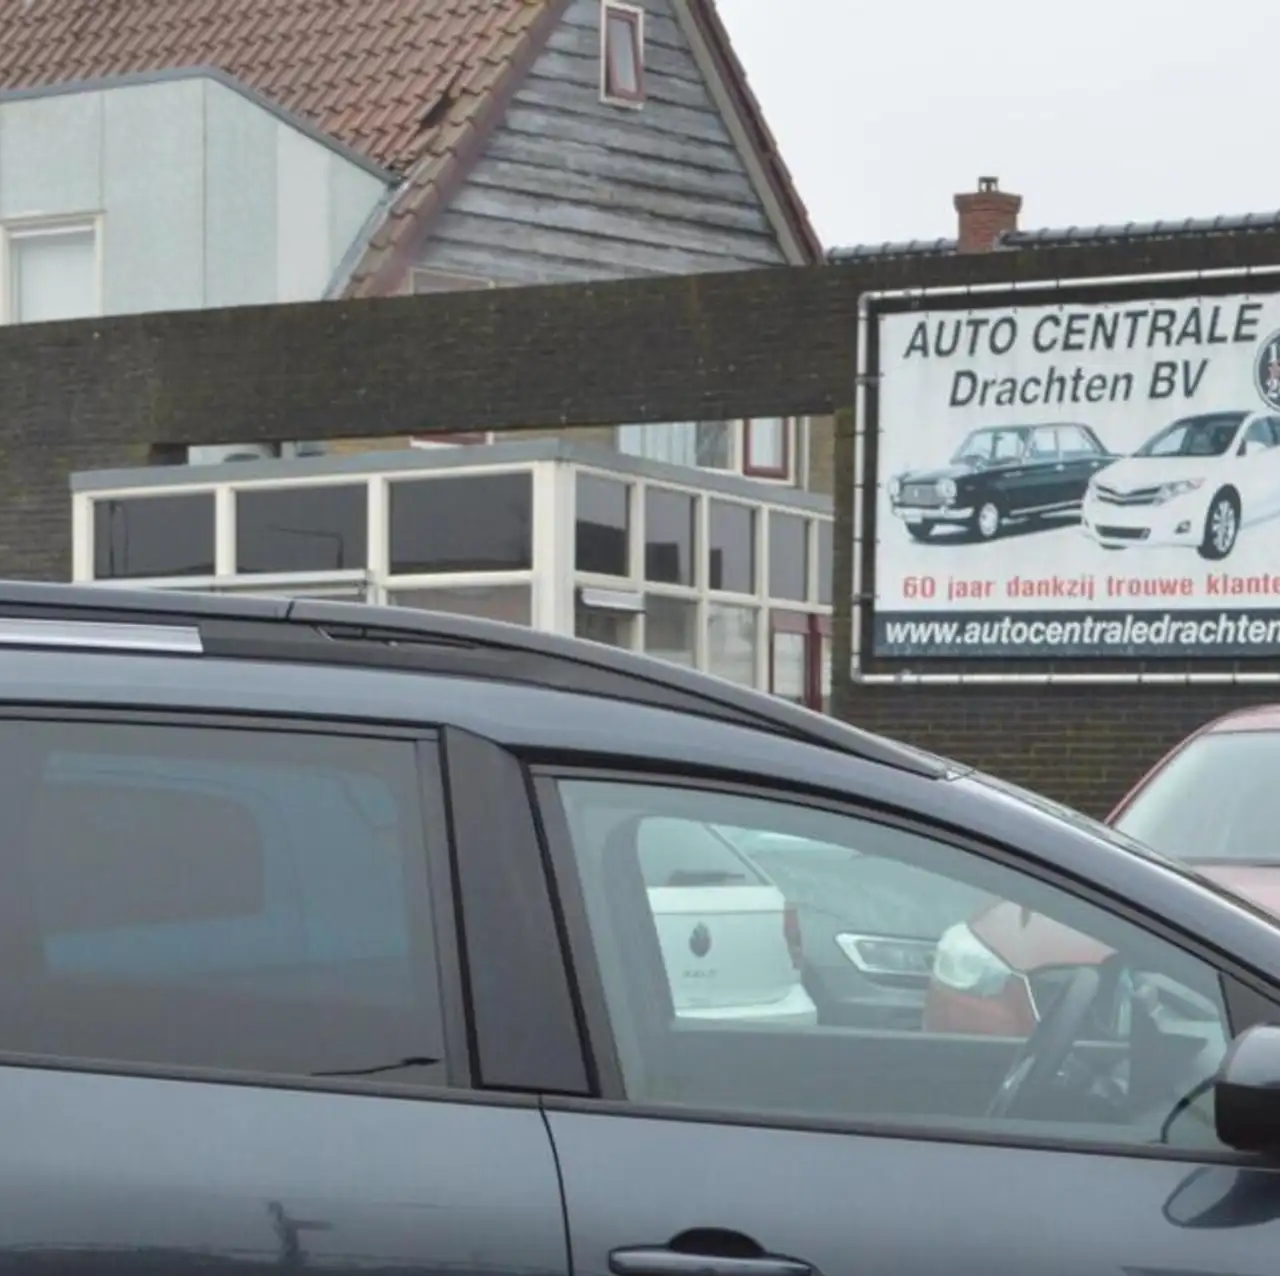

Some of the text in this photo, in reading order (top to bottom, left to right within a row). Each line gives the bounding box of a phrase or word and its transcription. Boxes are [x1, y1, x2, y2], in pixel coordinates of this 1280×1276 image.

[903, 302, 1263, 358] AUTO CENTRALE
[948, 358, 1210, 408] Drachten BV
[902, 575, 936, 599] 60
[947, 575, 995, 601] jaar
[1006, 573, 1095, 601] dankzij
[1106, 575, 1193, 597] trouwe
